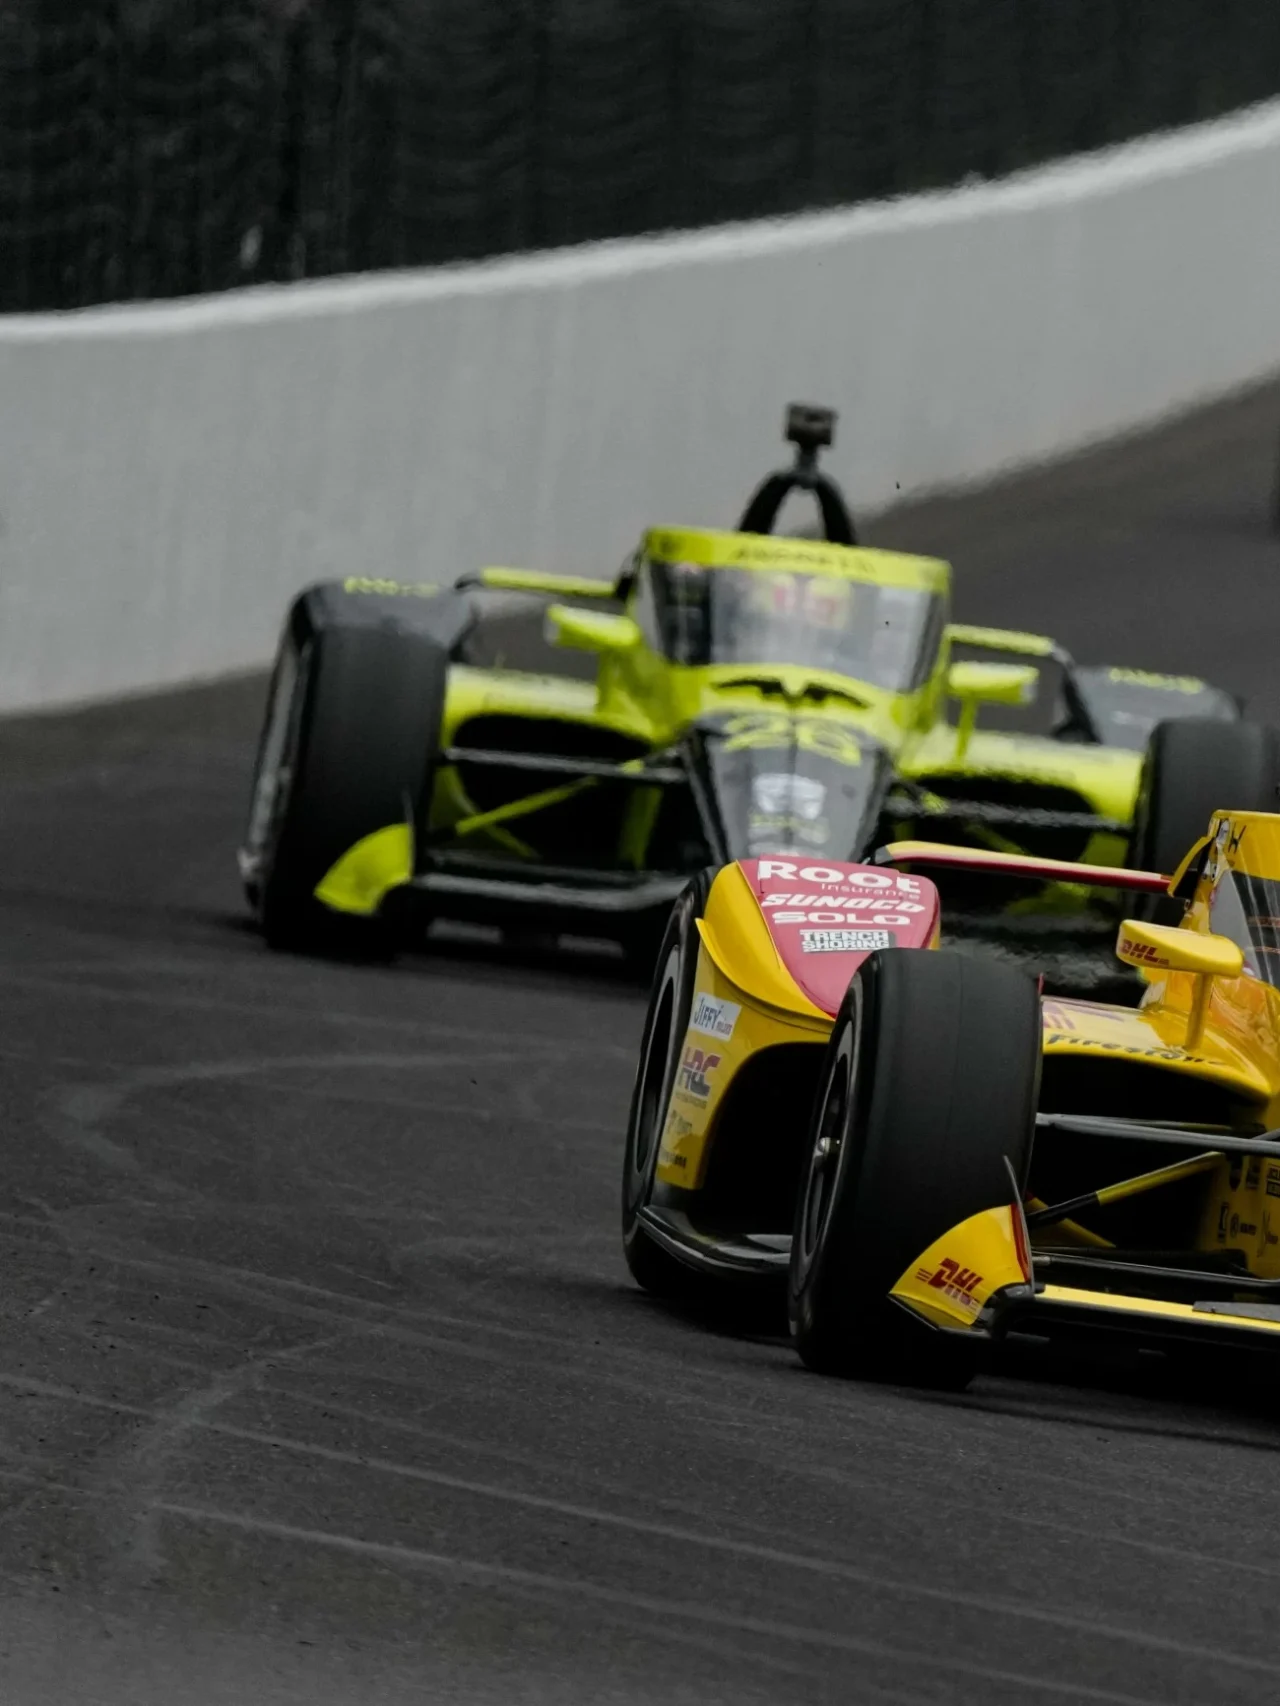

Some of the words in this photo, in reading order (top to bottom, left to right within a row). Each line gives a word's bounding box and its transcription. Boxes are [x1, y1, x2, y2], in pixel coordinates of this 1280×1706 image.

[761, 893, 925, 912] SUNOCO
[772, 911, 911, 925] SOLO
[800, 930, 889, 941] TRENCH
[802, 940, 890, 949] SHORING
[1121, 939, 1160, 963] DHL
[694, 997, 724, 1031] JIFFY
